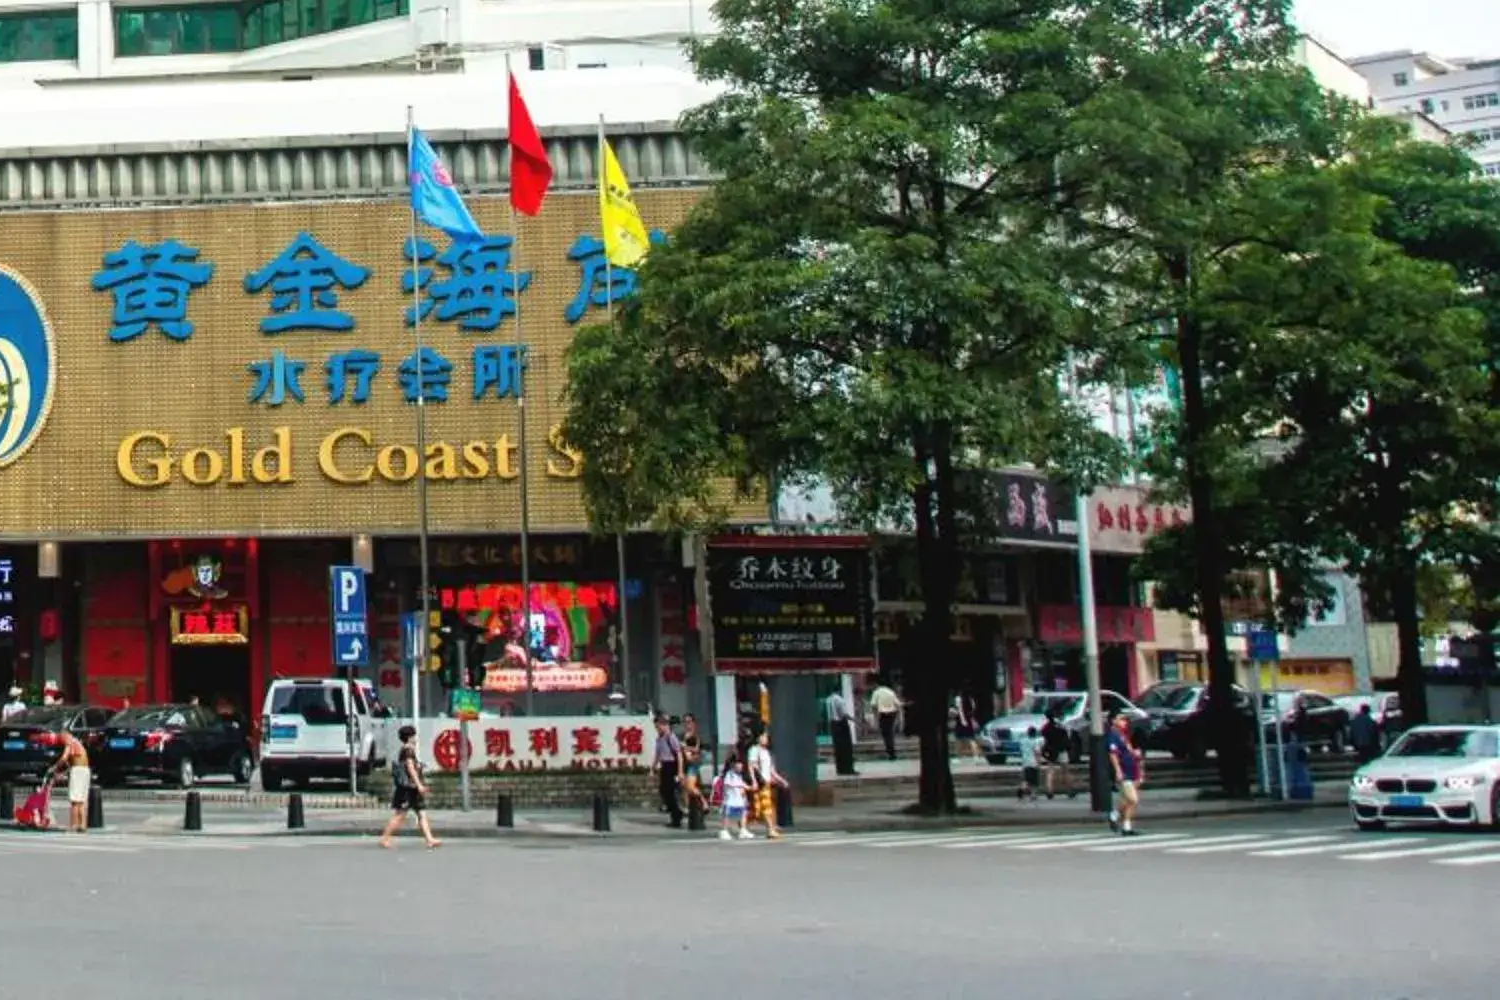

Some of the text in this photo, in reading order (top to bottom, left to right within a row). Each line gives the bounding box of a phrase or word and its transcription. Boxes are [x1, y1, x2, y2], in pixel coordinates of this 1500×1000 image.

[247, 344, 530, 407] 水疗会所
[117, 424, 292, 488] Gold
[318, 426, 522, 483] Coast
[341, 571, 358, 612] P
[483, 726, 644, 757] 凯利宾馆
[572, 757, 639, 770] HOTEL
